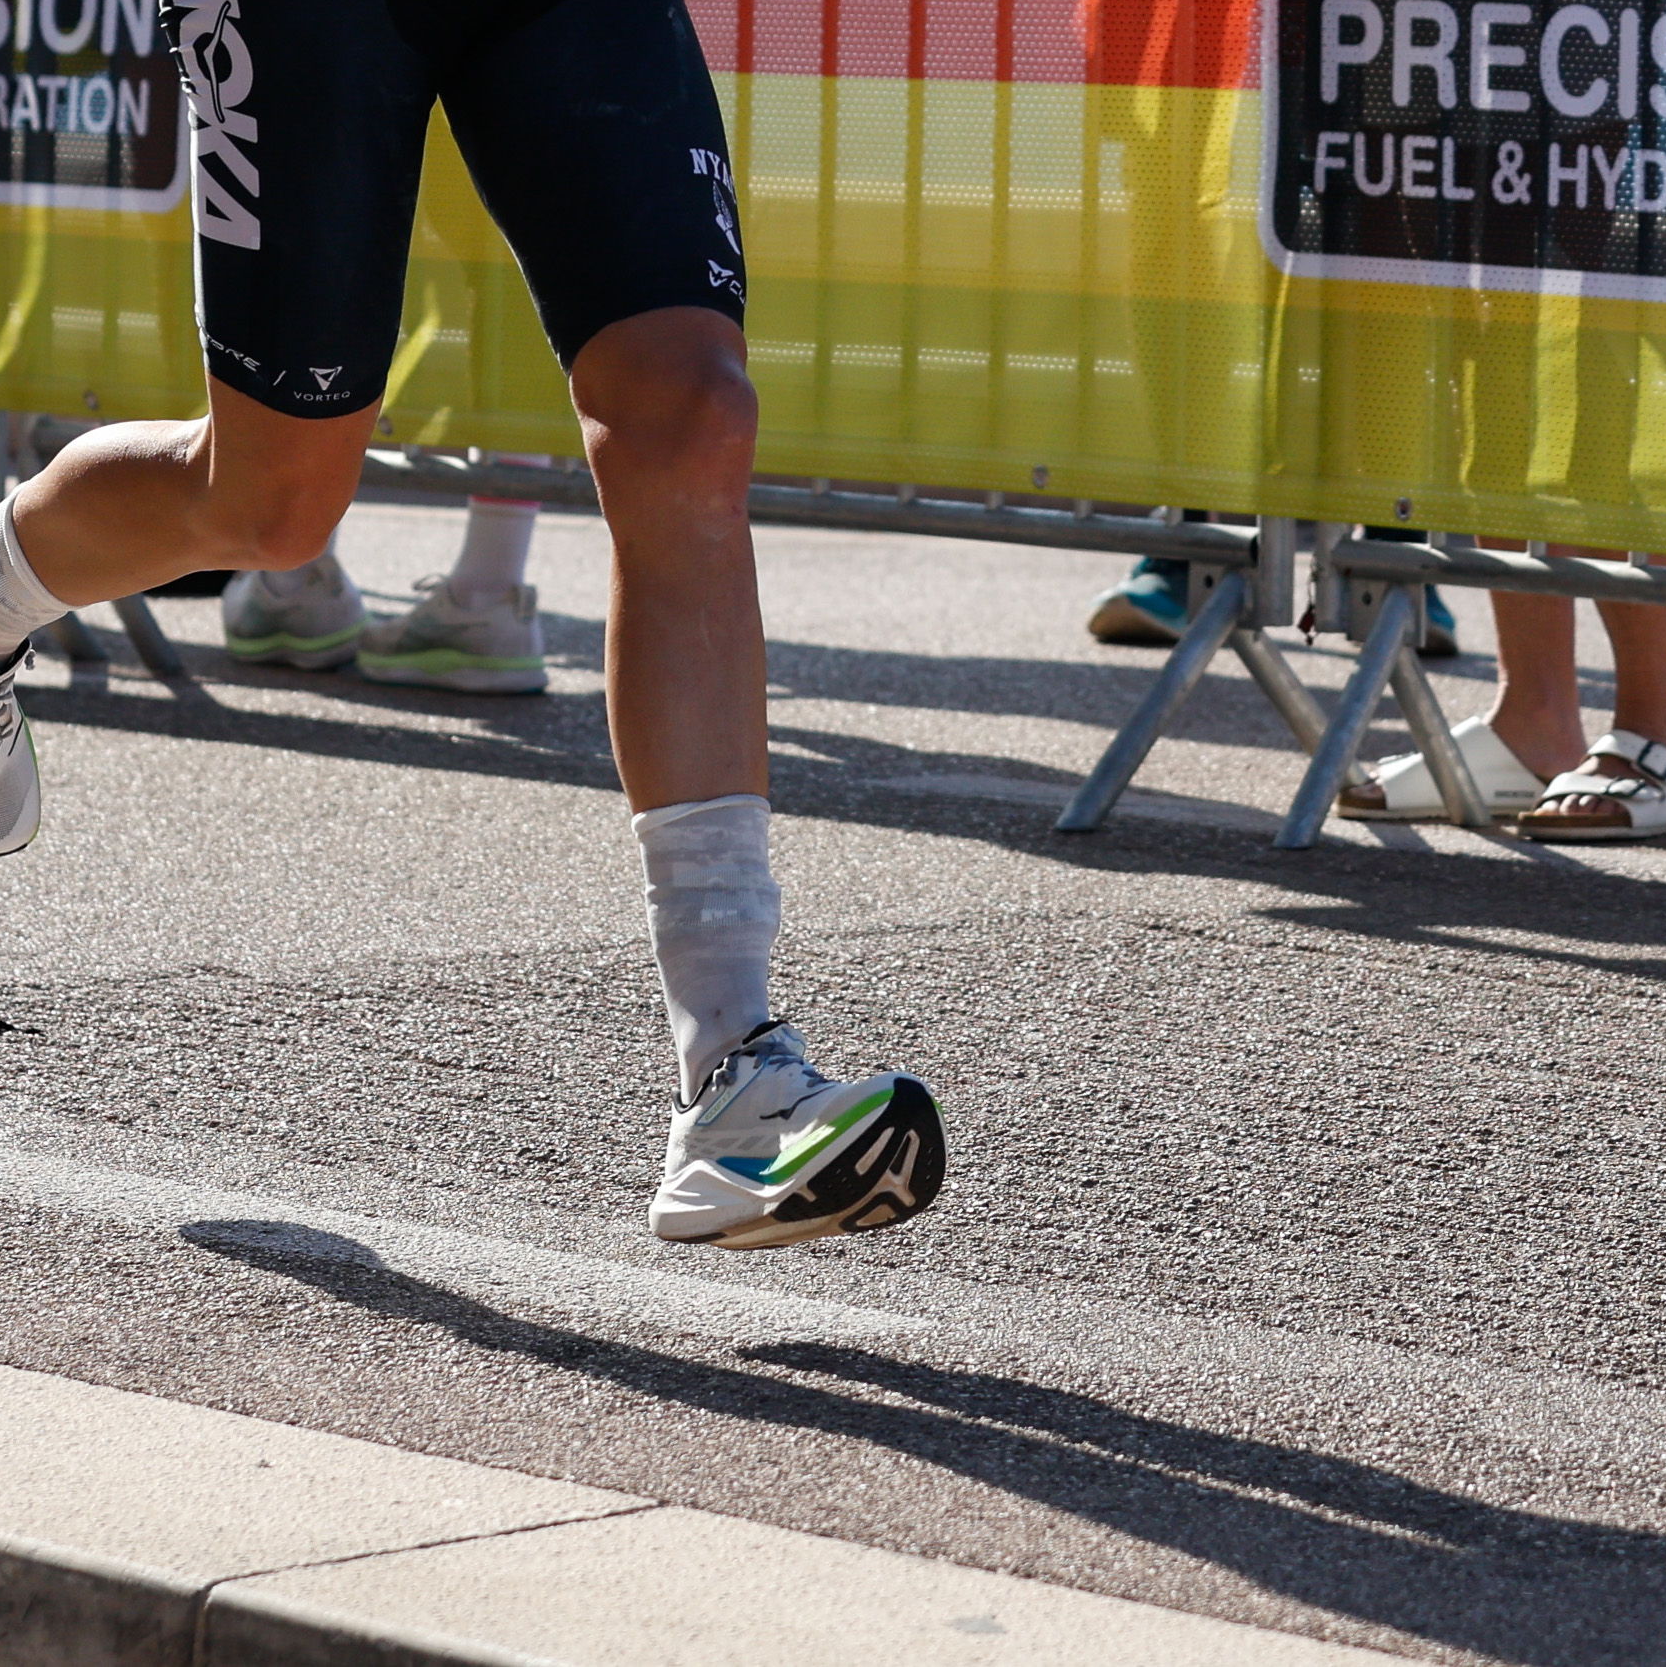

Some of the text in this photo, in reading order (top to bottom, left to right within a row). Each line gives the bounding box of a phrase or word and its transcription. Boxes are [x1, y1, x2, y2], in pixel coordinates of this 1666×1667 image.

[1313, 131, 1475, 200] FUEL
[1491, 140, 1532, 205] &
[293, 390, 351, 402] VORTEQ
